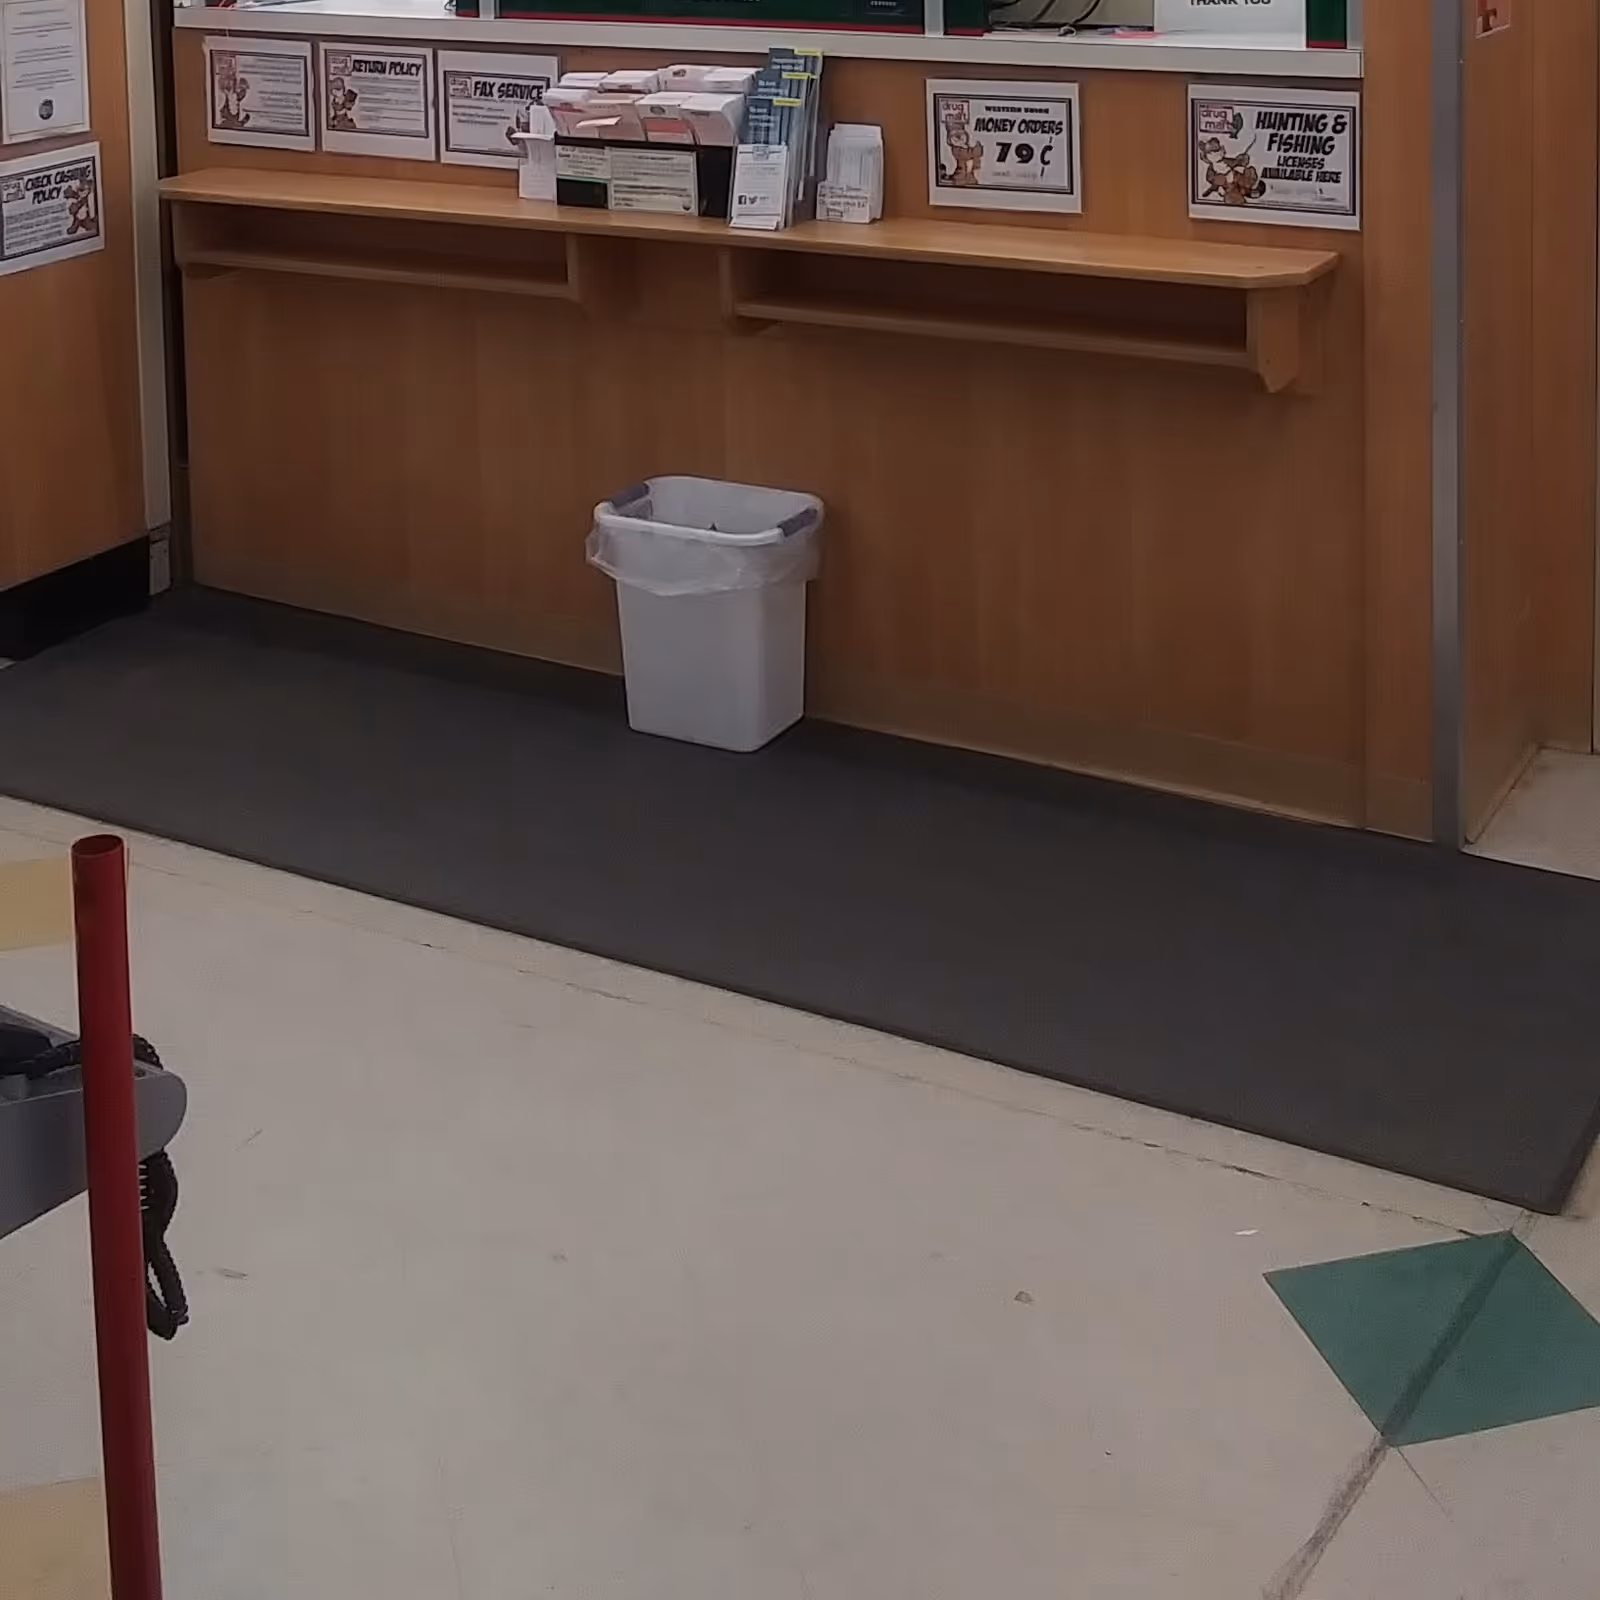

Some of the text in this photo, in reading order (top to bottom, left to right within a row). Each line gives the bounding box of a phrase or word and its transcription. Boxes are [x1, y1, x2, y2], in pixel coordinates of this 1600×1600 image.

[352, 59, 386, 74] RETURN
[389, 61, 421, 76] POLICY
[473, 81, 496, 97] FAX
[497, 82, 544, 100] SERVICE
[942, 102, 964, 112] drug
[1201, 108, 1228, 120] drug
[974, 117, 1063, 135] MONEY ORDERS
[1256, 111, 1347, 134] HUNTING &
[1267, 133, 1335, 155] FISHING
[1277, 155, 1325, 170] LICENSES
[25, 173, 54, 191] CHECK
[1315, 170, 1342, 183] HERE
[32, 187, 62, 205] POLICY
